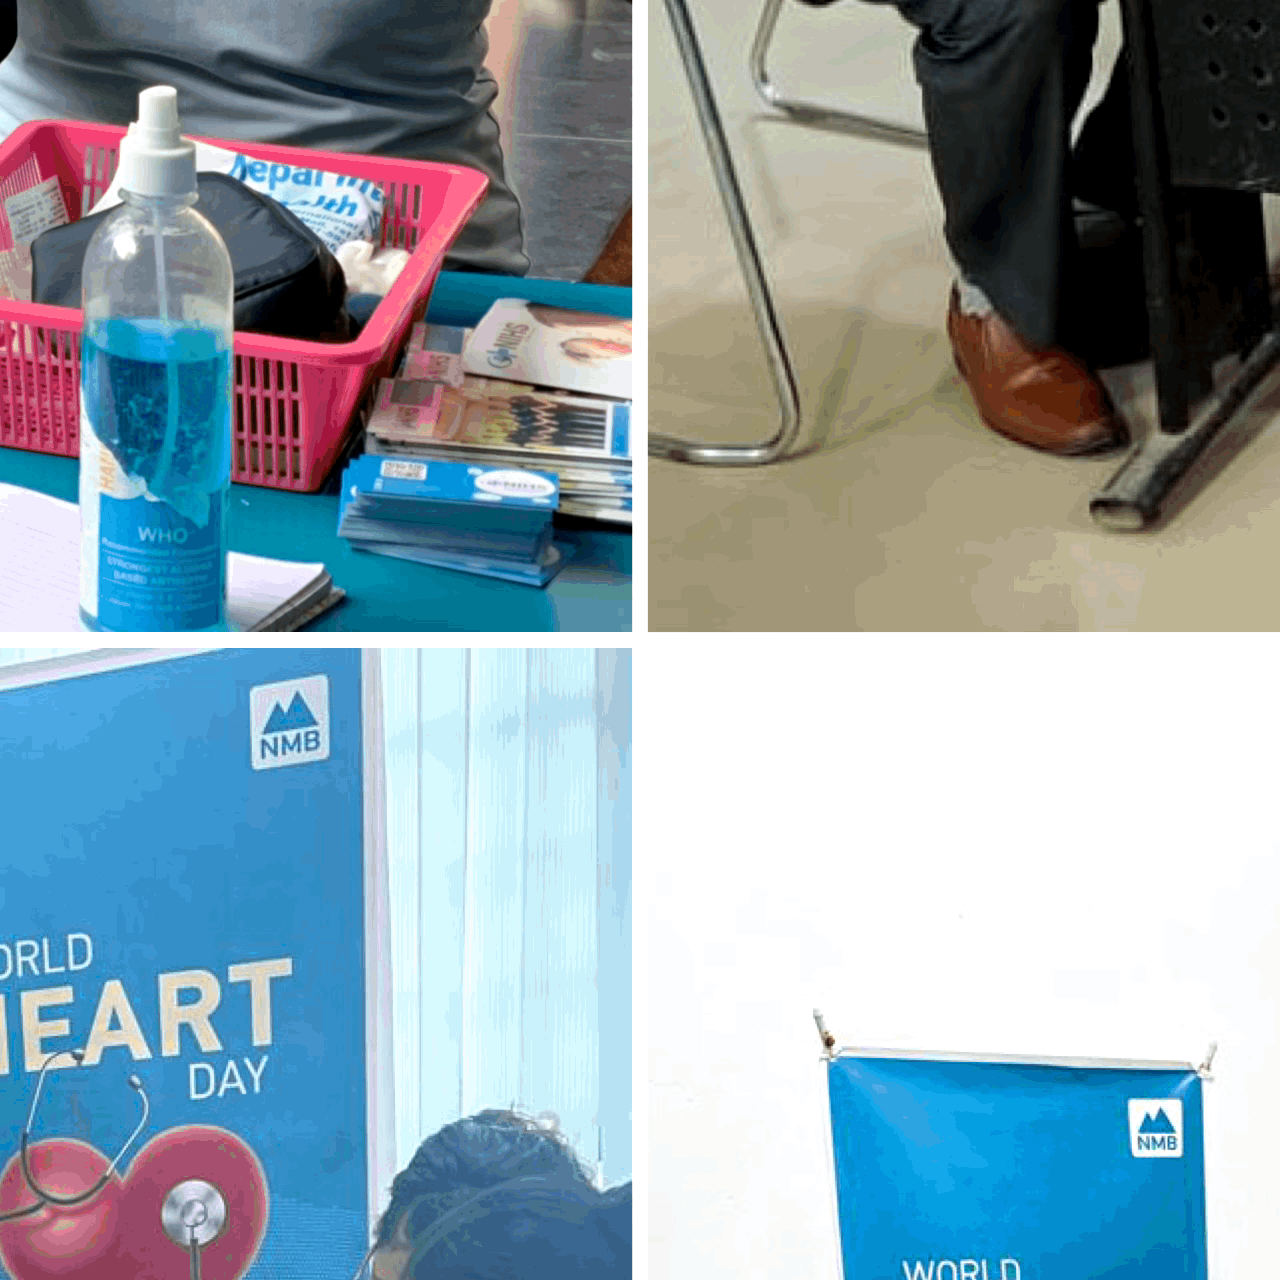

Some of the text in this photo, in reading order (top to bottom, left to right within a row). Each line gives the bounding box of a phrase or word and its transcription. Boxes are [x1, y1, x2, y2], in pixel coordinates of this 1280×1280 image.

[137, 525, 189, 544] WHO
[261, 730, 321, 760] NMB
[187, 1055, 269, 1101] DAY
[1137, 1135, 1178, 1151] NMB
